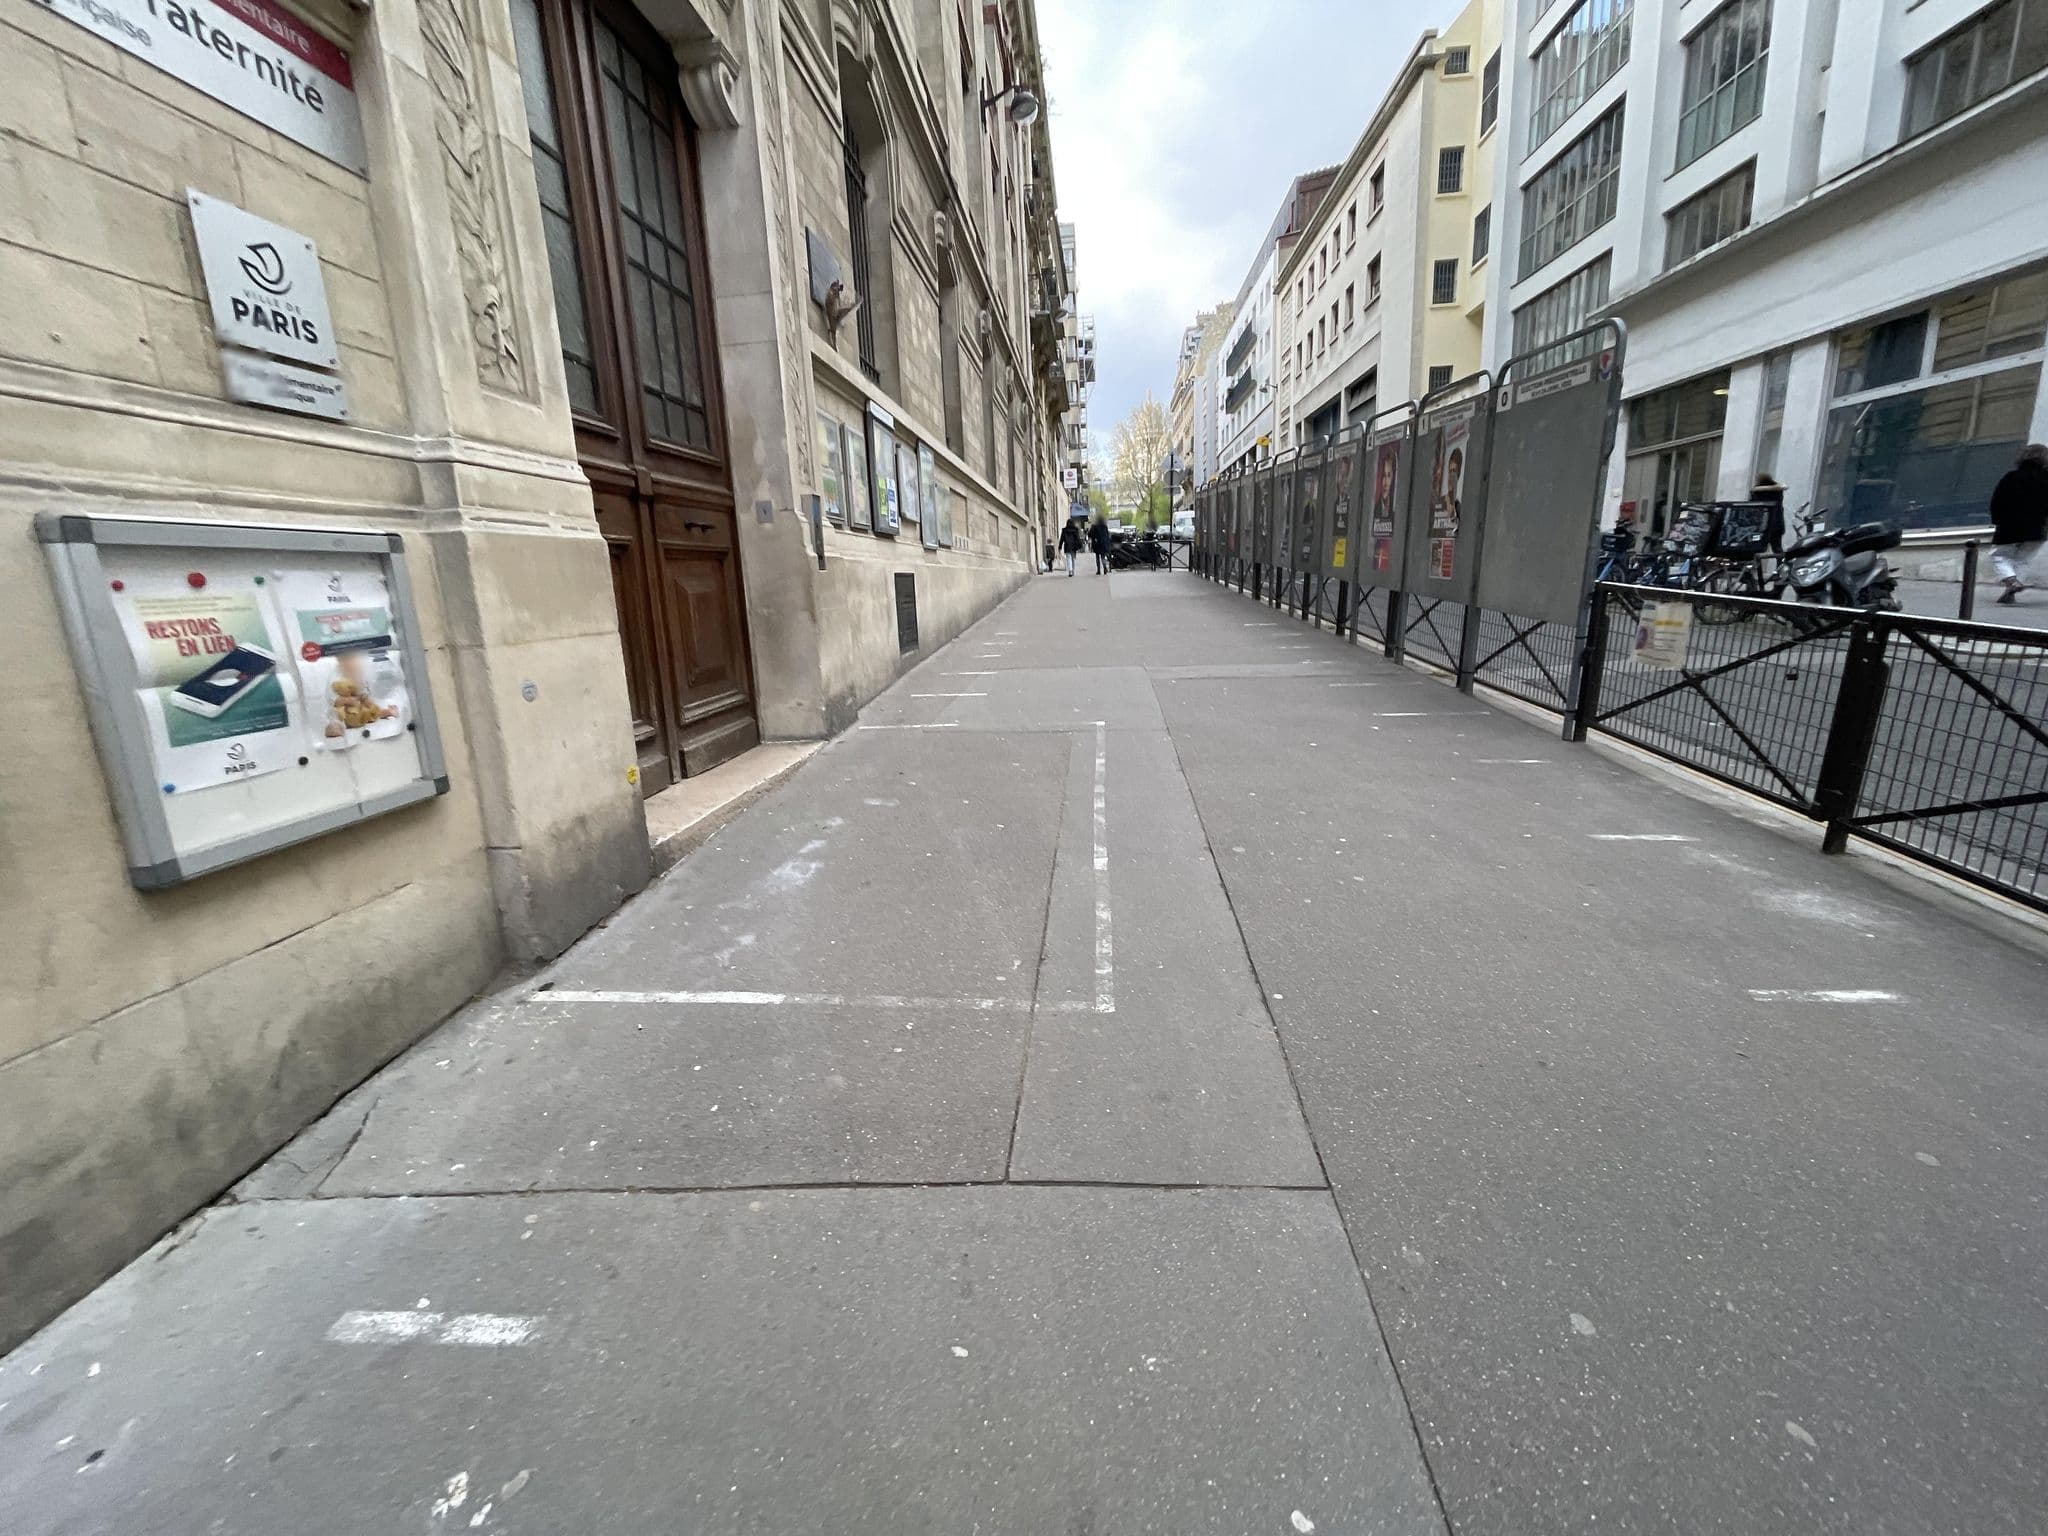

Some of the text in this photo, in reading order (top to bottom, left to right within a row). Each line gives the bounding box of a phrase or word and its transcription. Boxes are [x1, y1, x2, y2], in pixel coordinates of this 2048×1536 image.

[231, 296, 319, 344] PARIS
[145, 617, 223, 639] RESTONS
[176, 634, 236, 657] EN LIEN
[224, 761, 257, 775] PARIS
